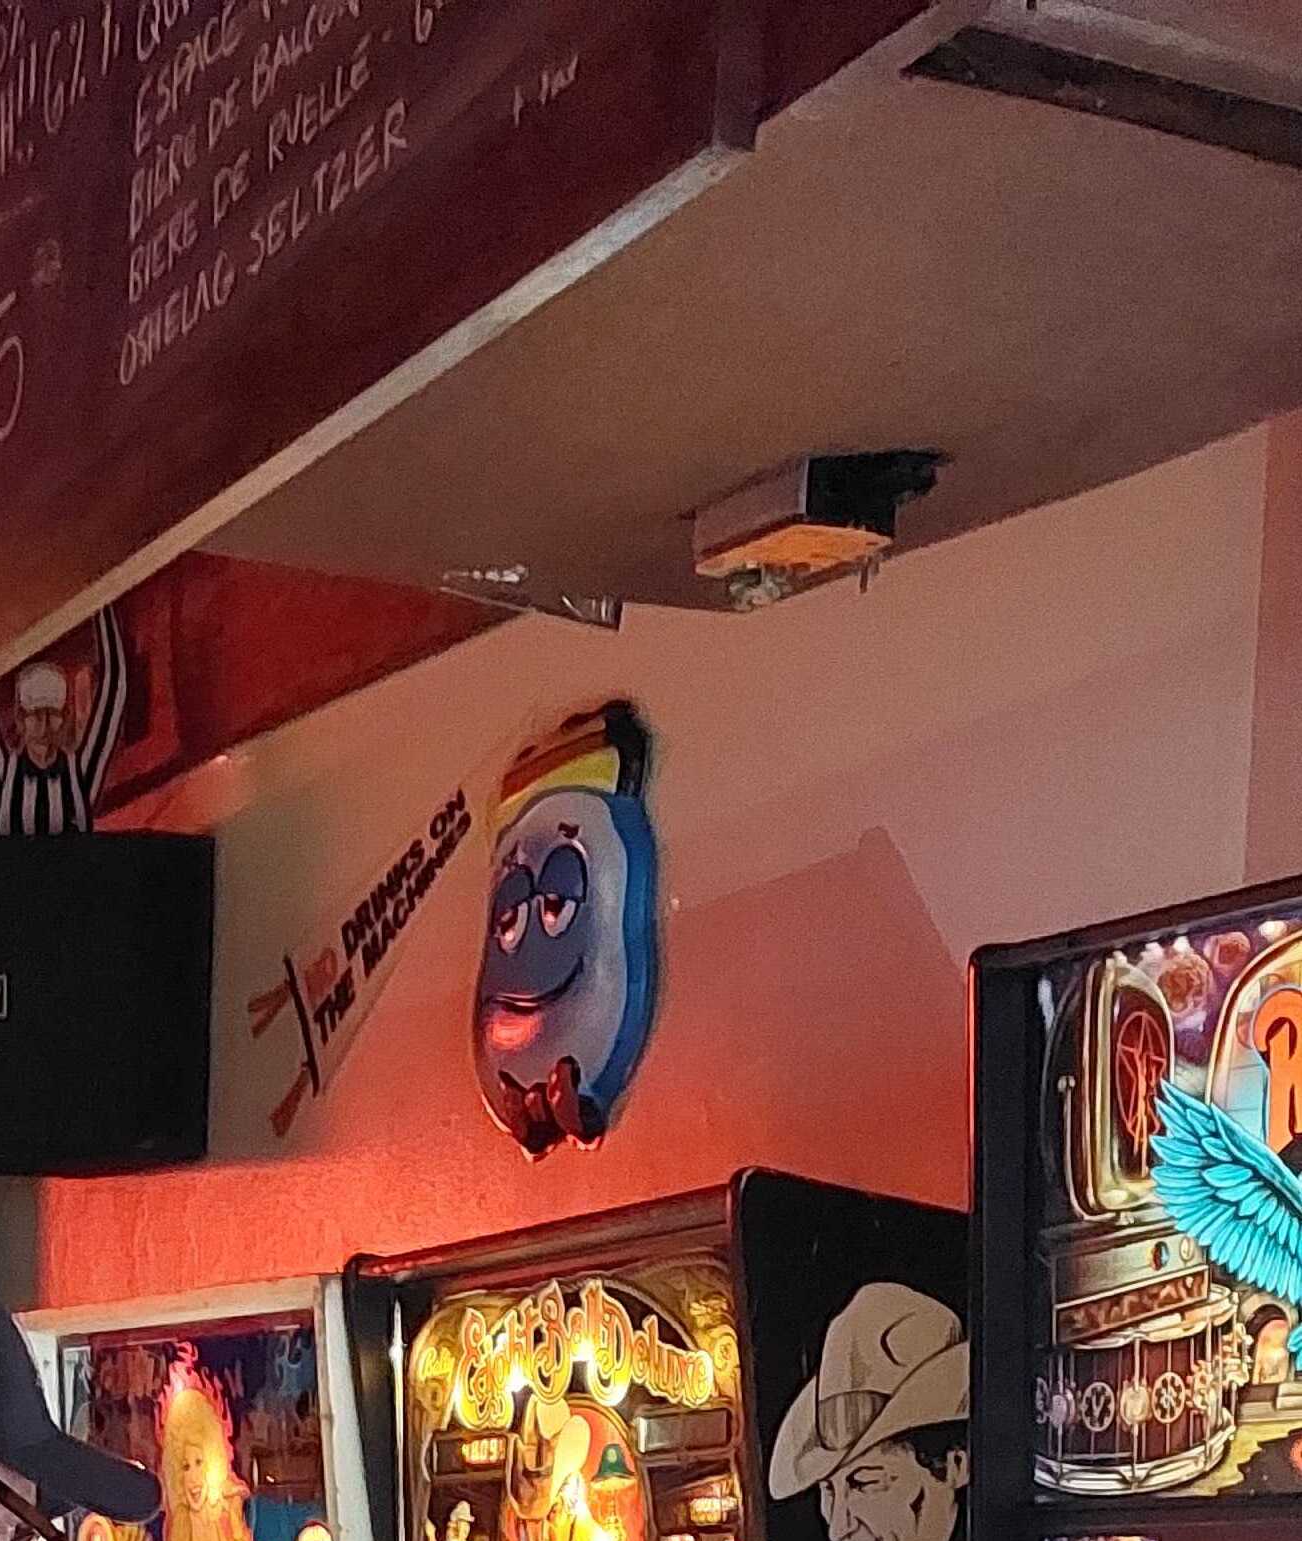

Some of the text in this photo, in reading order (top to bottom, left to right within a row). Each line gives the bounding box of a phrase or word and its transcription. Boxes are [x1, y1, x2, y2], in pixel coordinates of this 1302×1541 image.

[247, 97, 409, 276] SELTZER
[313, 811, 472, 1047] THE MACHINES
[341, 838, 425, 963] DRINKS
[429, 786, 466, 840] ON
